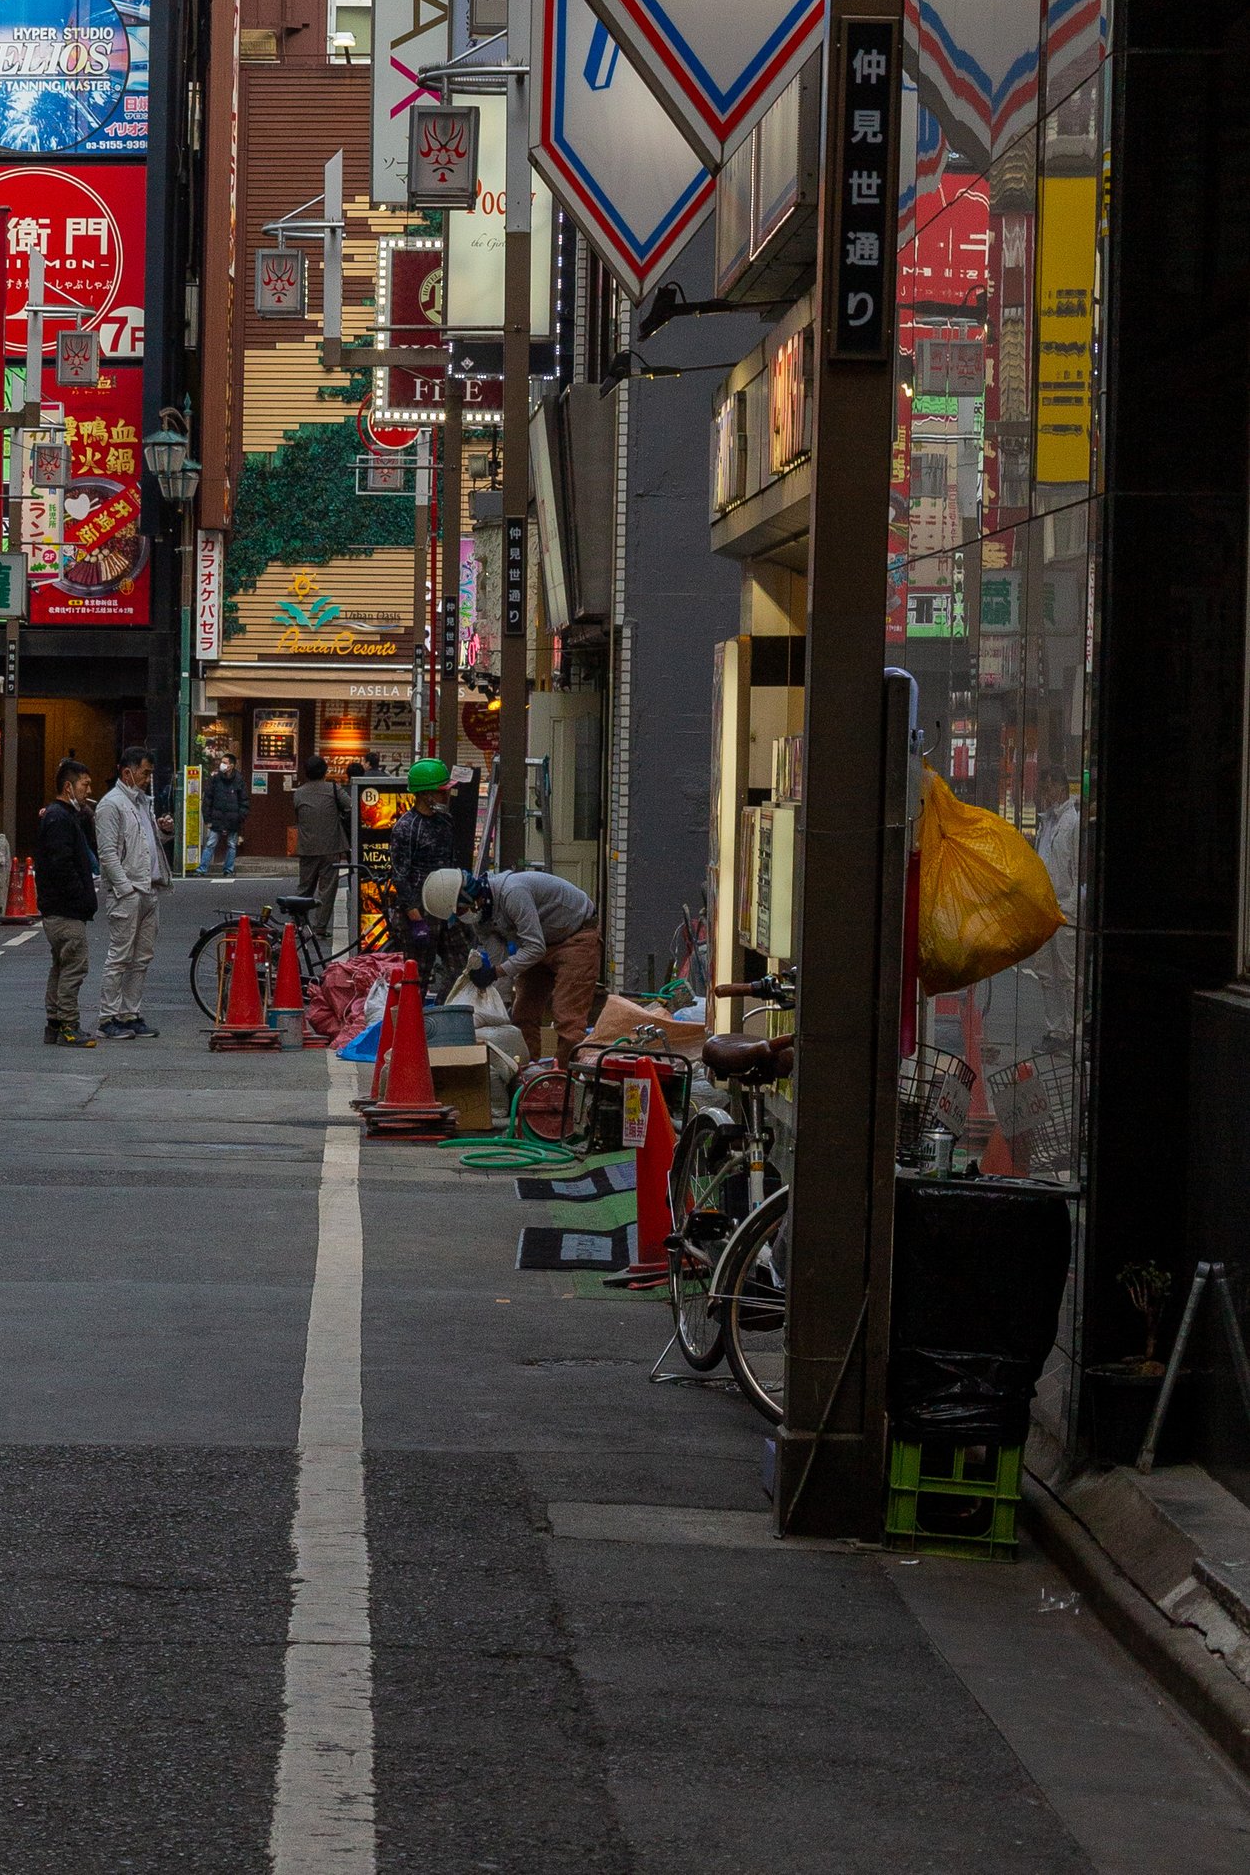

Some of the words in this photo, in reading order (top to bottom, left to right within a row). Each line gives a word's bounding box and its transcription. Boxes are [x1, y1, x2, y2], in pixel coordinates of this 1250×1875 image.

[13, 27, 57, 40] HYPER
[63, 27, 114, 40] STUDIO
[6, 81, 61, 92] TANNING
[64, 81, 111, 91] MASTER
[846, 48, 887, 327] 仲見世通り
[101, 315, 145, 353] 7F
[412, 379, 483, 402] FIE
[70, 447, 136, 475] 火鍋
[44, 552, 55, 561] 2F
[509, 526, 521, 624] 仲見世通り
[199, 538, 217, 651] カラオケパセラ
[376, 611, 402, 621] Oasis
[277, 626, 329, 655] Pasela
[329, 630, 398, 656] Resorts
[446, 602, 455, 671] 仲見世通り
[8, 643, 16, 692] 仲見世通り
[350, 685, 400, 697] PASELA
[364, 790, 377, 803] B1
[363, 851, 390, 862] MEA
